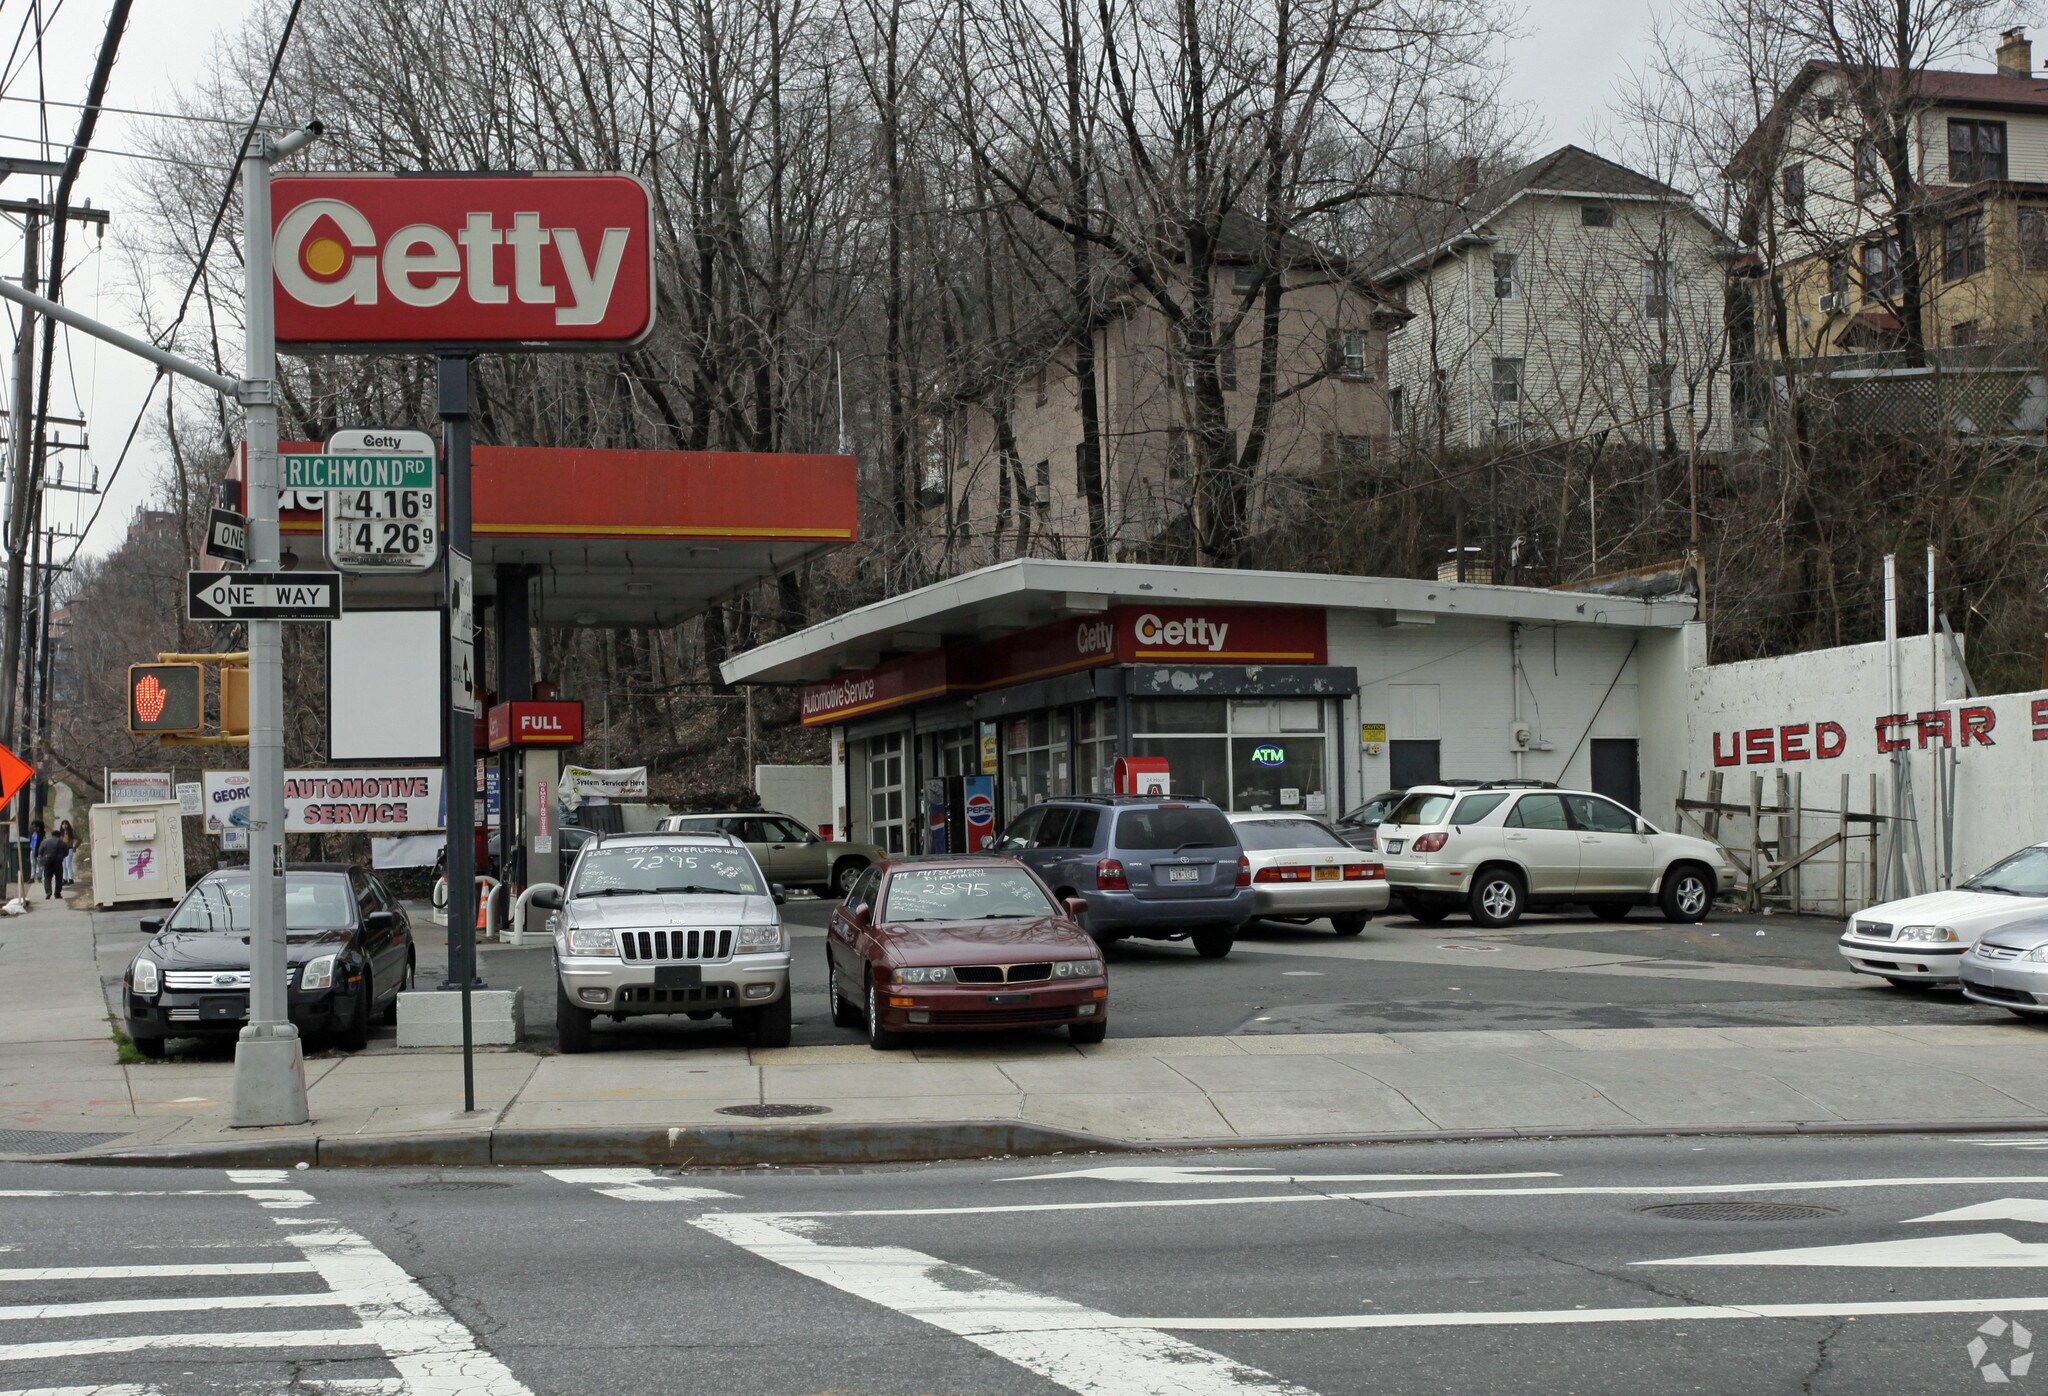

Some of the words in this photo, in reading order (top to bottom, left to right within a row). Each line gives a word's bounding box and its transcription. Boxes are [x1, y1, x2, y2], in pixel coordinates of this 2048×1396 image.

[272, 198, 630, 325] Getty
[363, 434, 402, 450] Getty
[290, 458, 404, 486] RICHMOND
[405, 460, 425, 474] RD
[222, 526, 244, 549] ONE
[212, 587, 255, 605] ONE
[276, 587, 321, 605] WAY
[1076, 621, 1114, 654] Getty
[1135, 613, 1229, 652] Getty
[802, 684, 844, 714] Automotive
[844, 678, 875, 706] Service
[521, 716, 562, 730] FULL
[1713, 720, 1847, 767] USED
[1874, 706, 1996, 754] CAR
[1252, 749, 1284, 762] ATM
[284, 777, 428, 799] AUTOMOTIVE
[576, 779, 600, 787] System
[601, 779, 628, 787] Serviced
[115, 789, 166, 798] PROTECTION
[303, 803, 408, 825] SERVICE
[966, 806, 992, 814] PEPSI
[669, 846, 722, 854] OVERLAND
[217, 975, 237, 984] Ford
